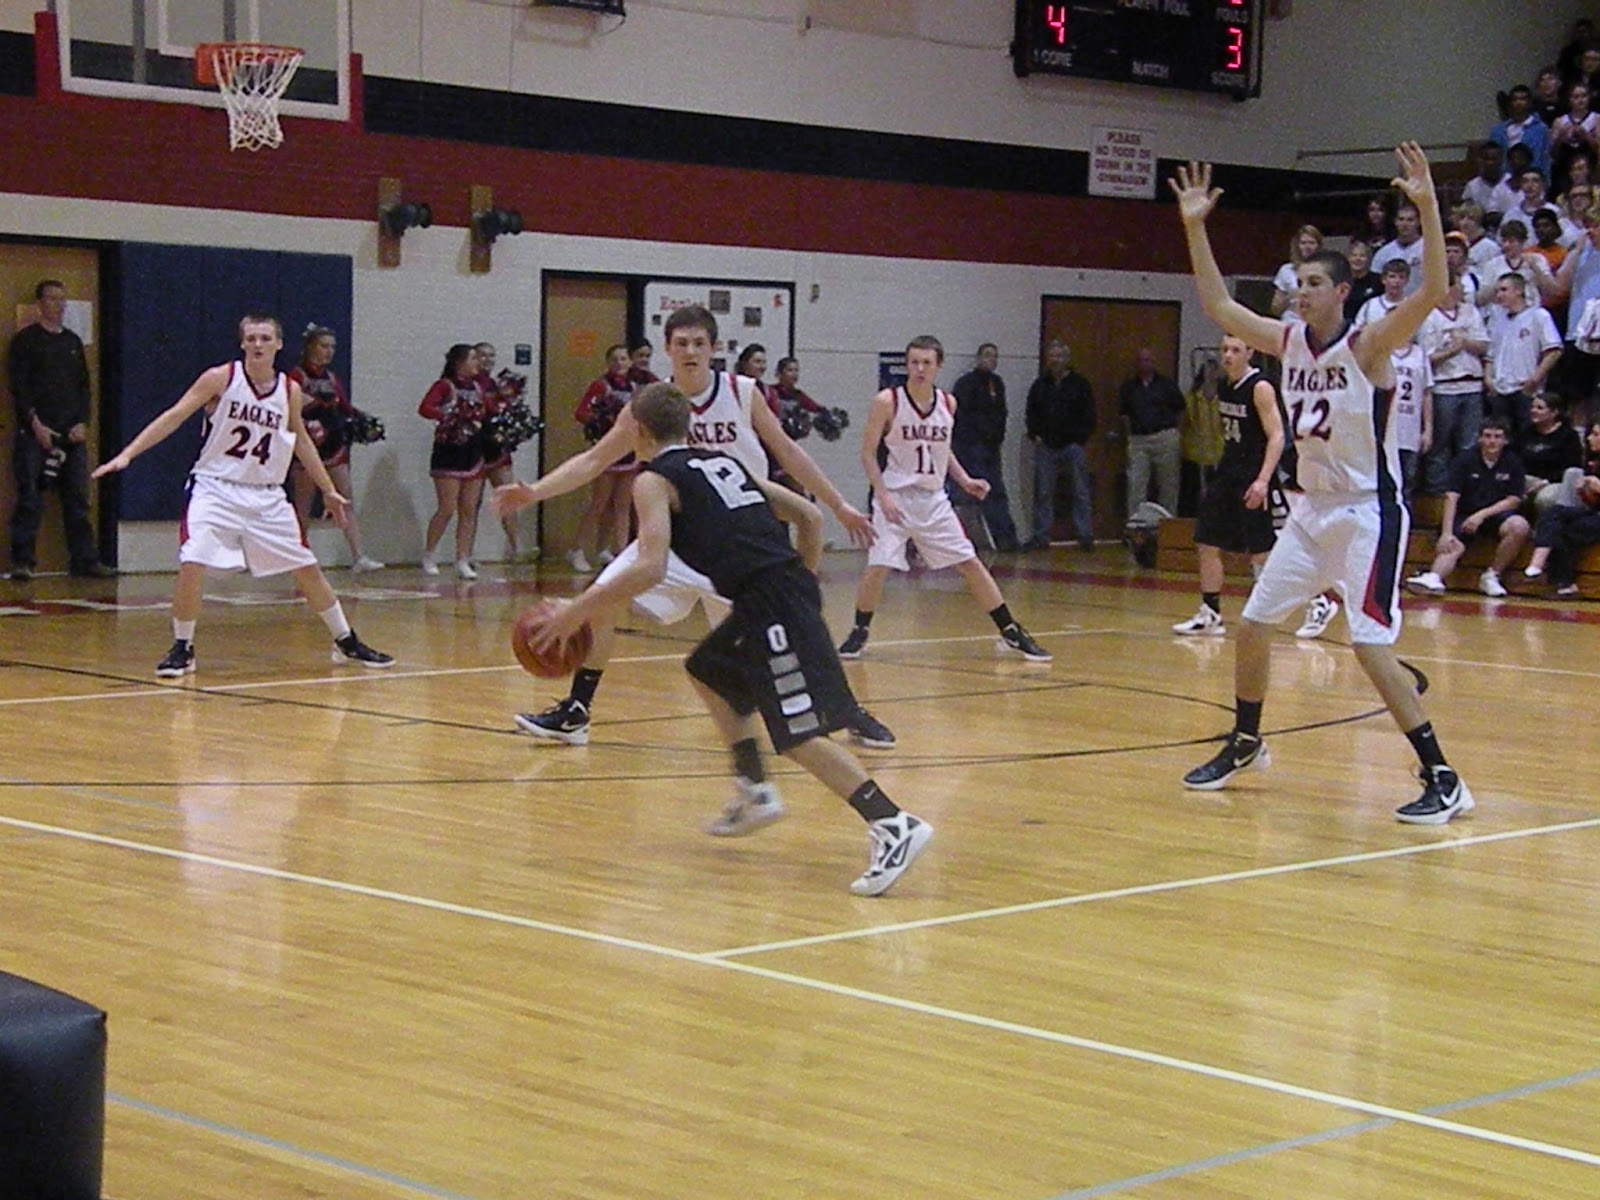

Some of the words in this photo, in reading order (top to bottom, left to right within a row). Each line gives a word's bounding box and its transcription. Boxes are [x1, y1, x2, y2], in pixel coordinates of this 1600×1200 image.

[1047, 5, 1066, 44] 4
[1227, 27, 1243, 68] 3
[1288, 366, 1348, 393] EAGLES
[228, 401, 283, 430] EAGLES
[1291, 398, 1332, 442] 12
[225, 425, 272, 465] 24
[687, 421, 738, 446] AGLES
[902, 424, 948, 442] EAGLES
[914, 443, 935, 475] 11
